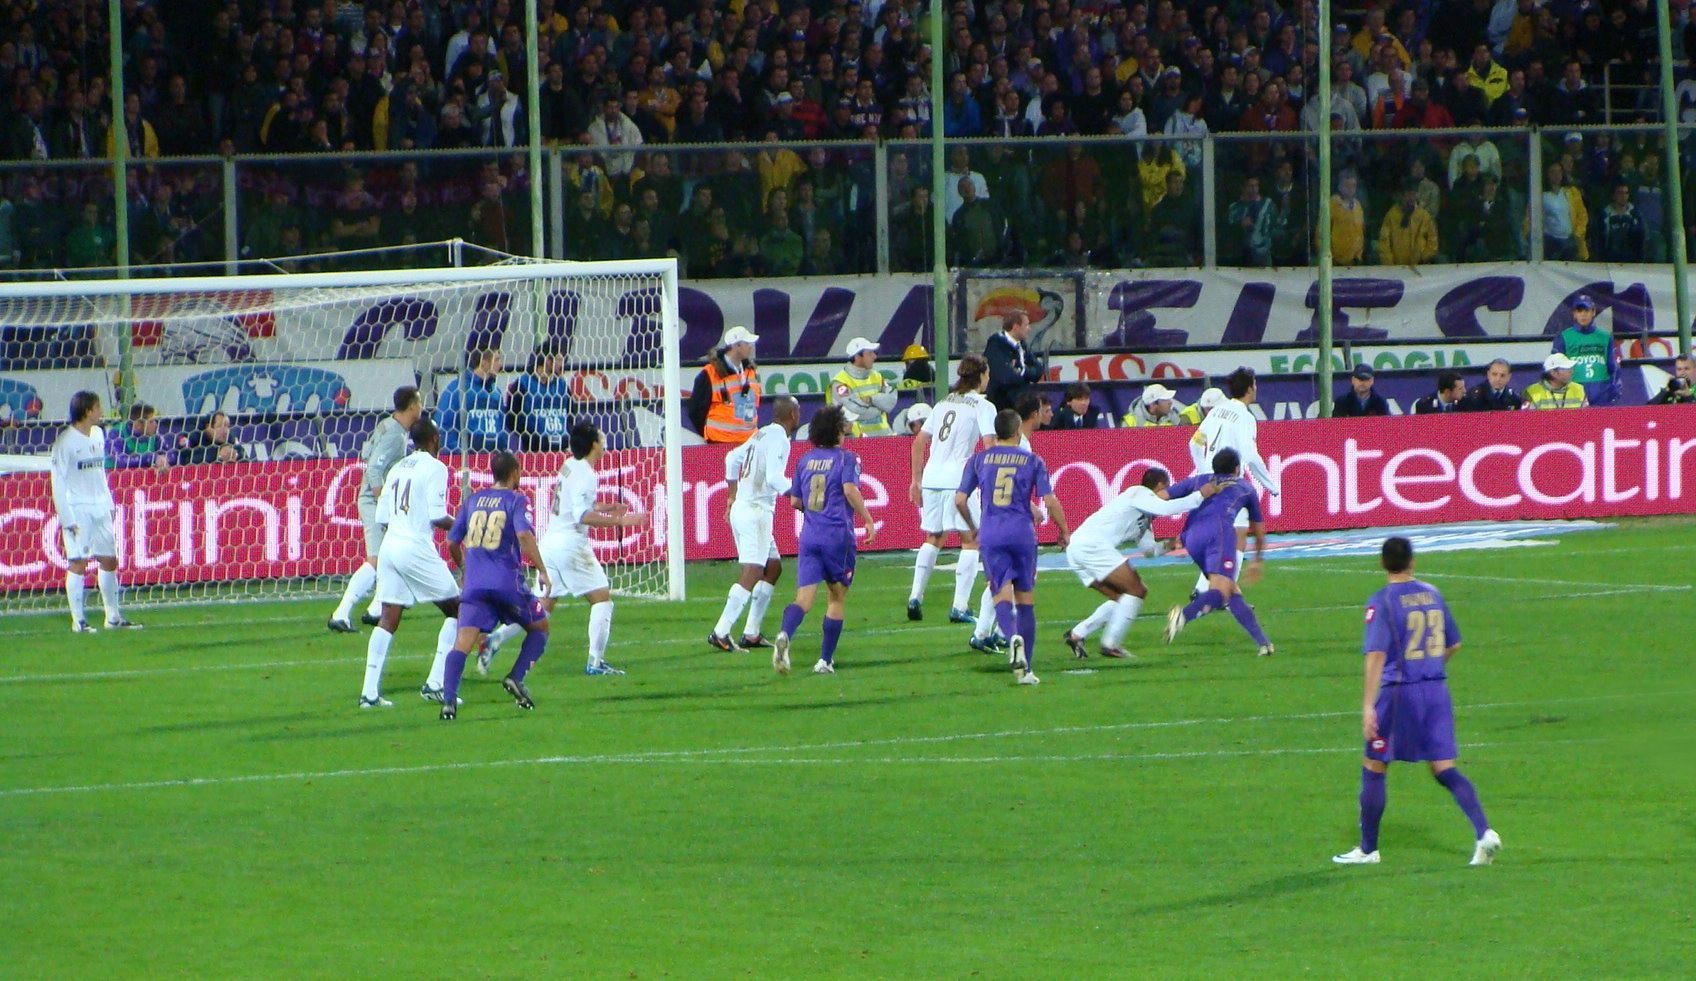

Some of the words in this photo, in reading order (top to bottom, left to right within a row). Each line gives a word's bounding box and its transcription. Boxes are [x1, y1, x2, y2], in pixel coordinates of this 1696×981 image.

[938, 409, 957, 442] 8
[391, 477, 411, 516] 14
[807, 473, 827, 511] 8
[992, 466, 1018, 507] 5
[463, 510, 507, 550] 88
[1404, 609, 1446, 661] 23
